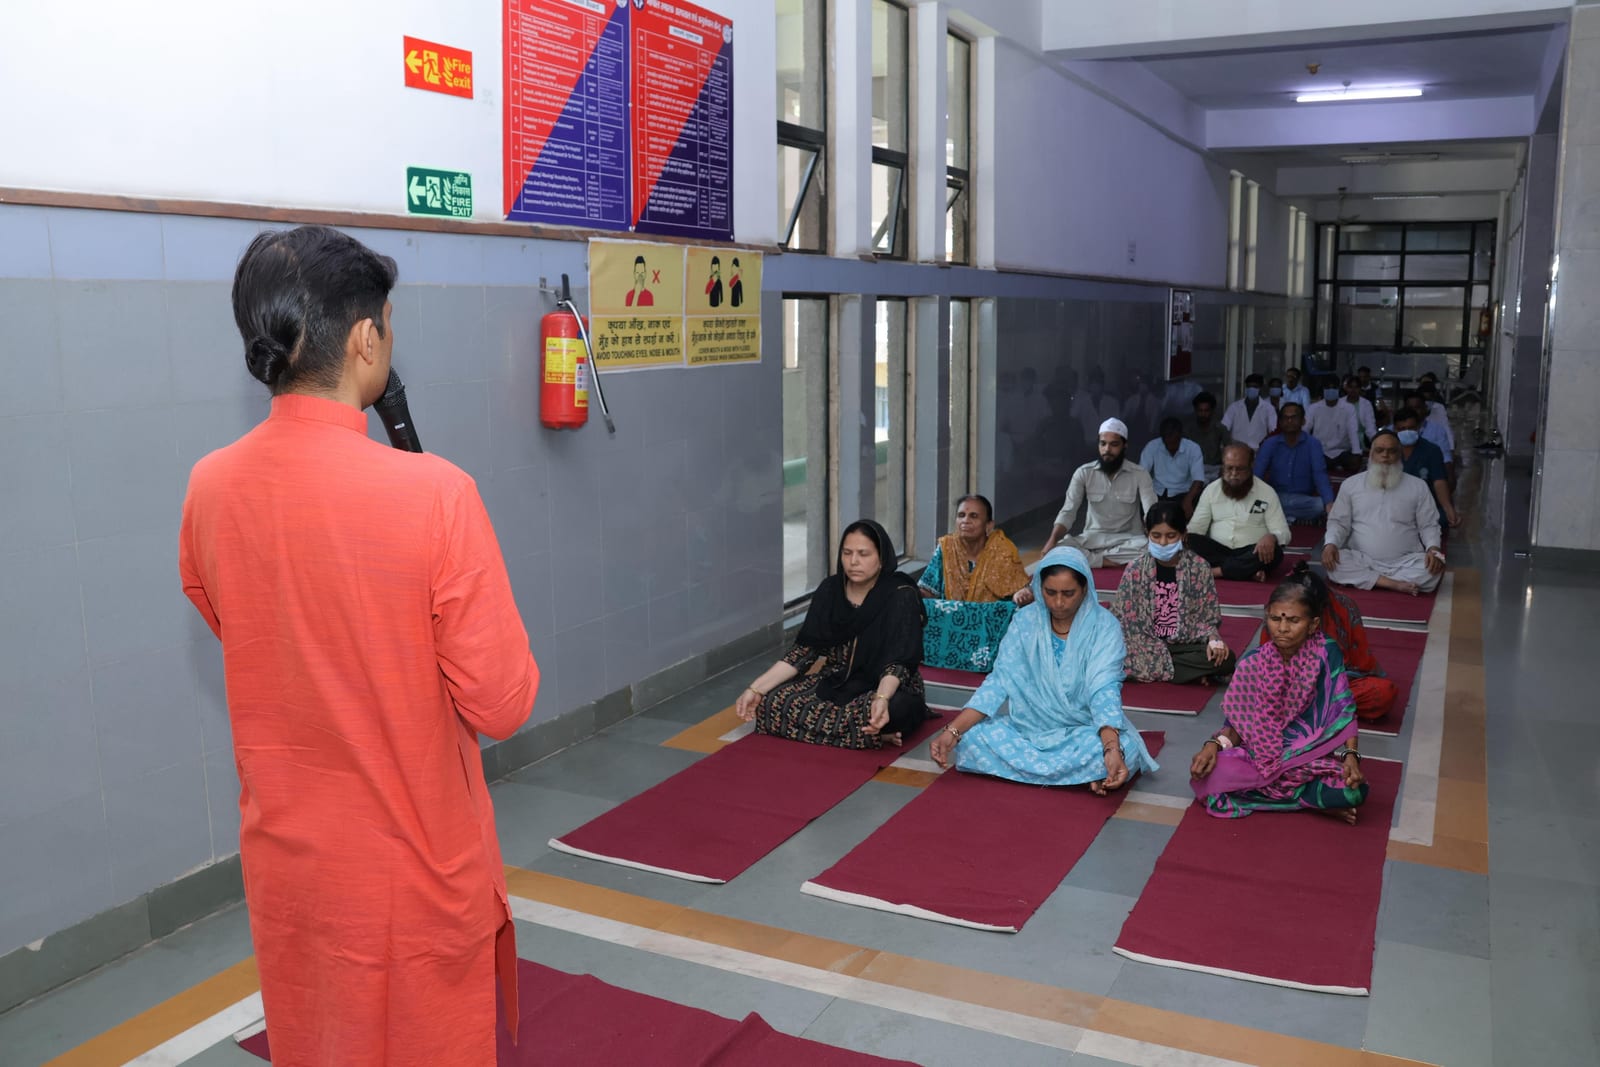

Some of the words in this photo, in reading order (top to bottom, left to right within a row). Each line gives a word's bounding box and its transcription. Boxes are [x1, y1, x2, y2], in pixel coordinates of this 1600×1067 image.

[452, 58, 471, 74] Fire
[453, 76, 471, 89] exit
[452, 196, 471, 207] FIRE
[452, 206, 471, 217] EXIT
[596, 351, 611, 360] AVOID
[611, 350, 635, 359] TOUCHING
[666, 347, 680, 356] MOUTH
